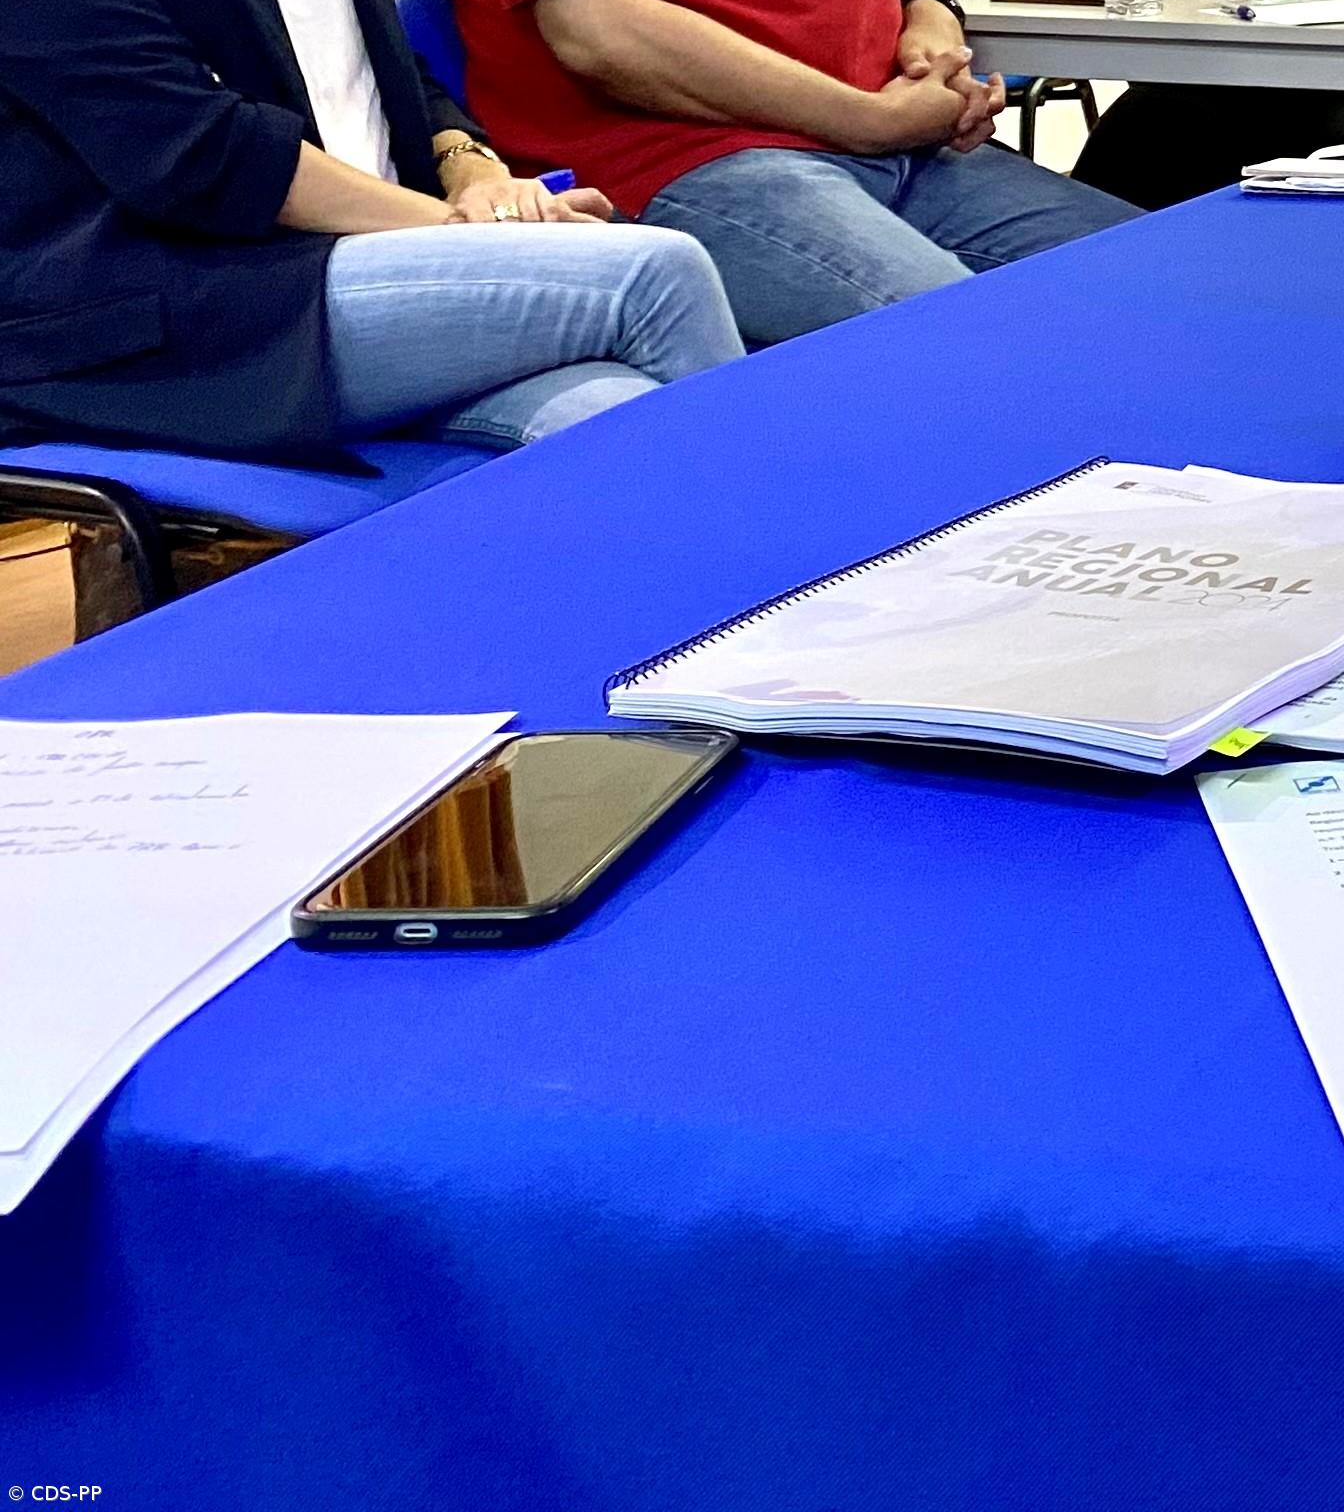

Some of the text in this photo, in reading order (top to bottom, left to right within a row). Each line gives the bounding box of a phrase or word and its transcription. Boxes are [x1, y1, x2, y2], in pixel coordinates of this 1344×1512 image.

[1018, 529, 1240, 568] PLANO
[949, 565, 1165, 602] ANUAL
[984, 545, 1313, 594] REGIONAL
